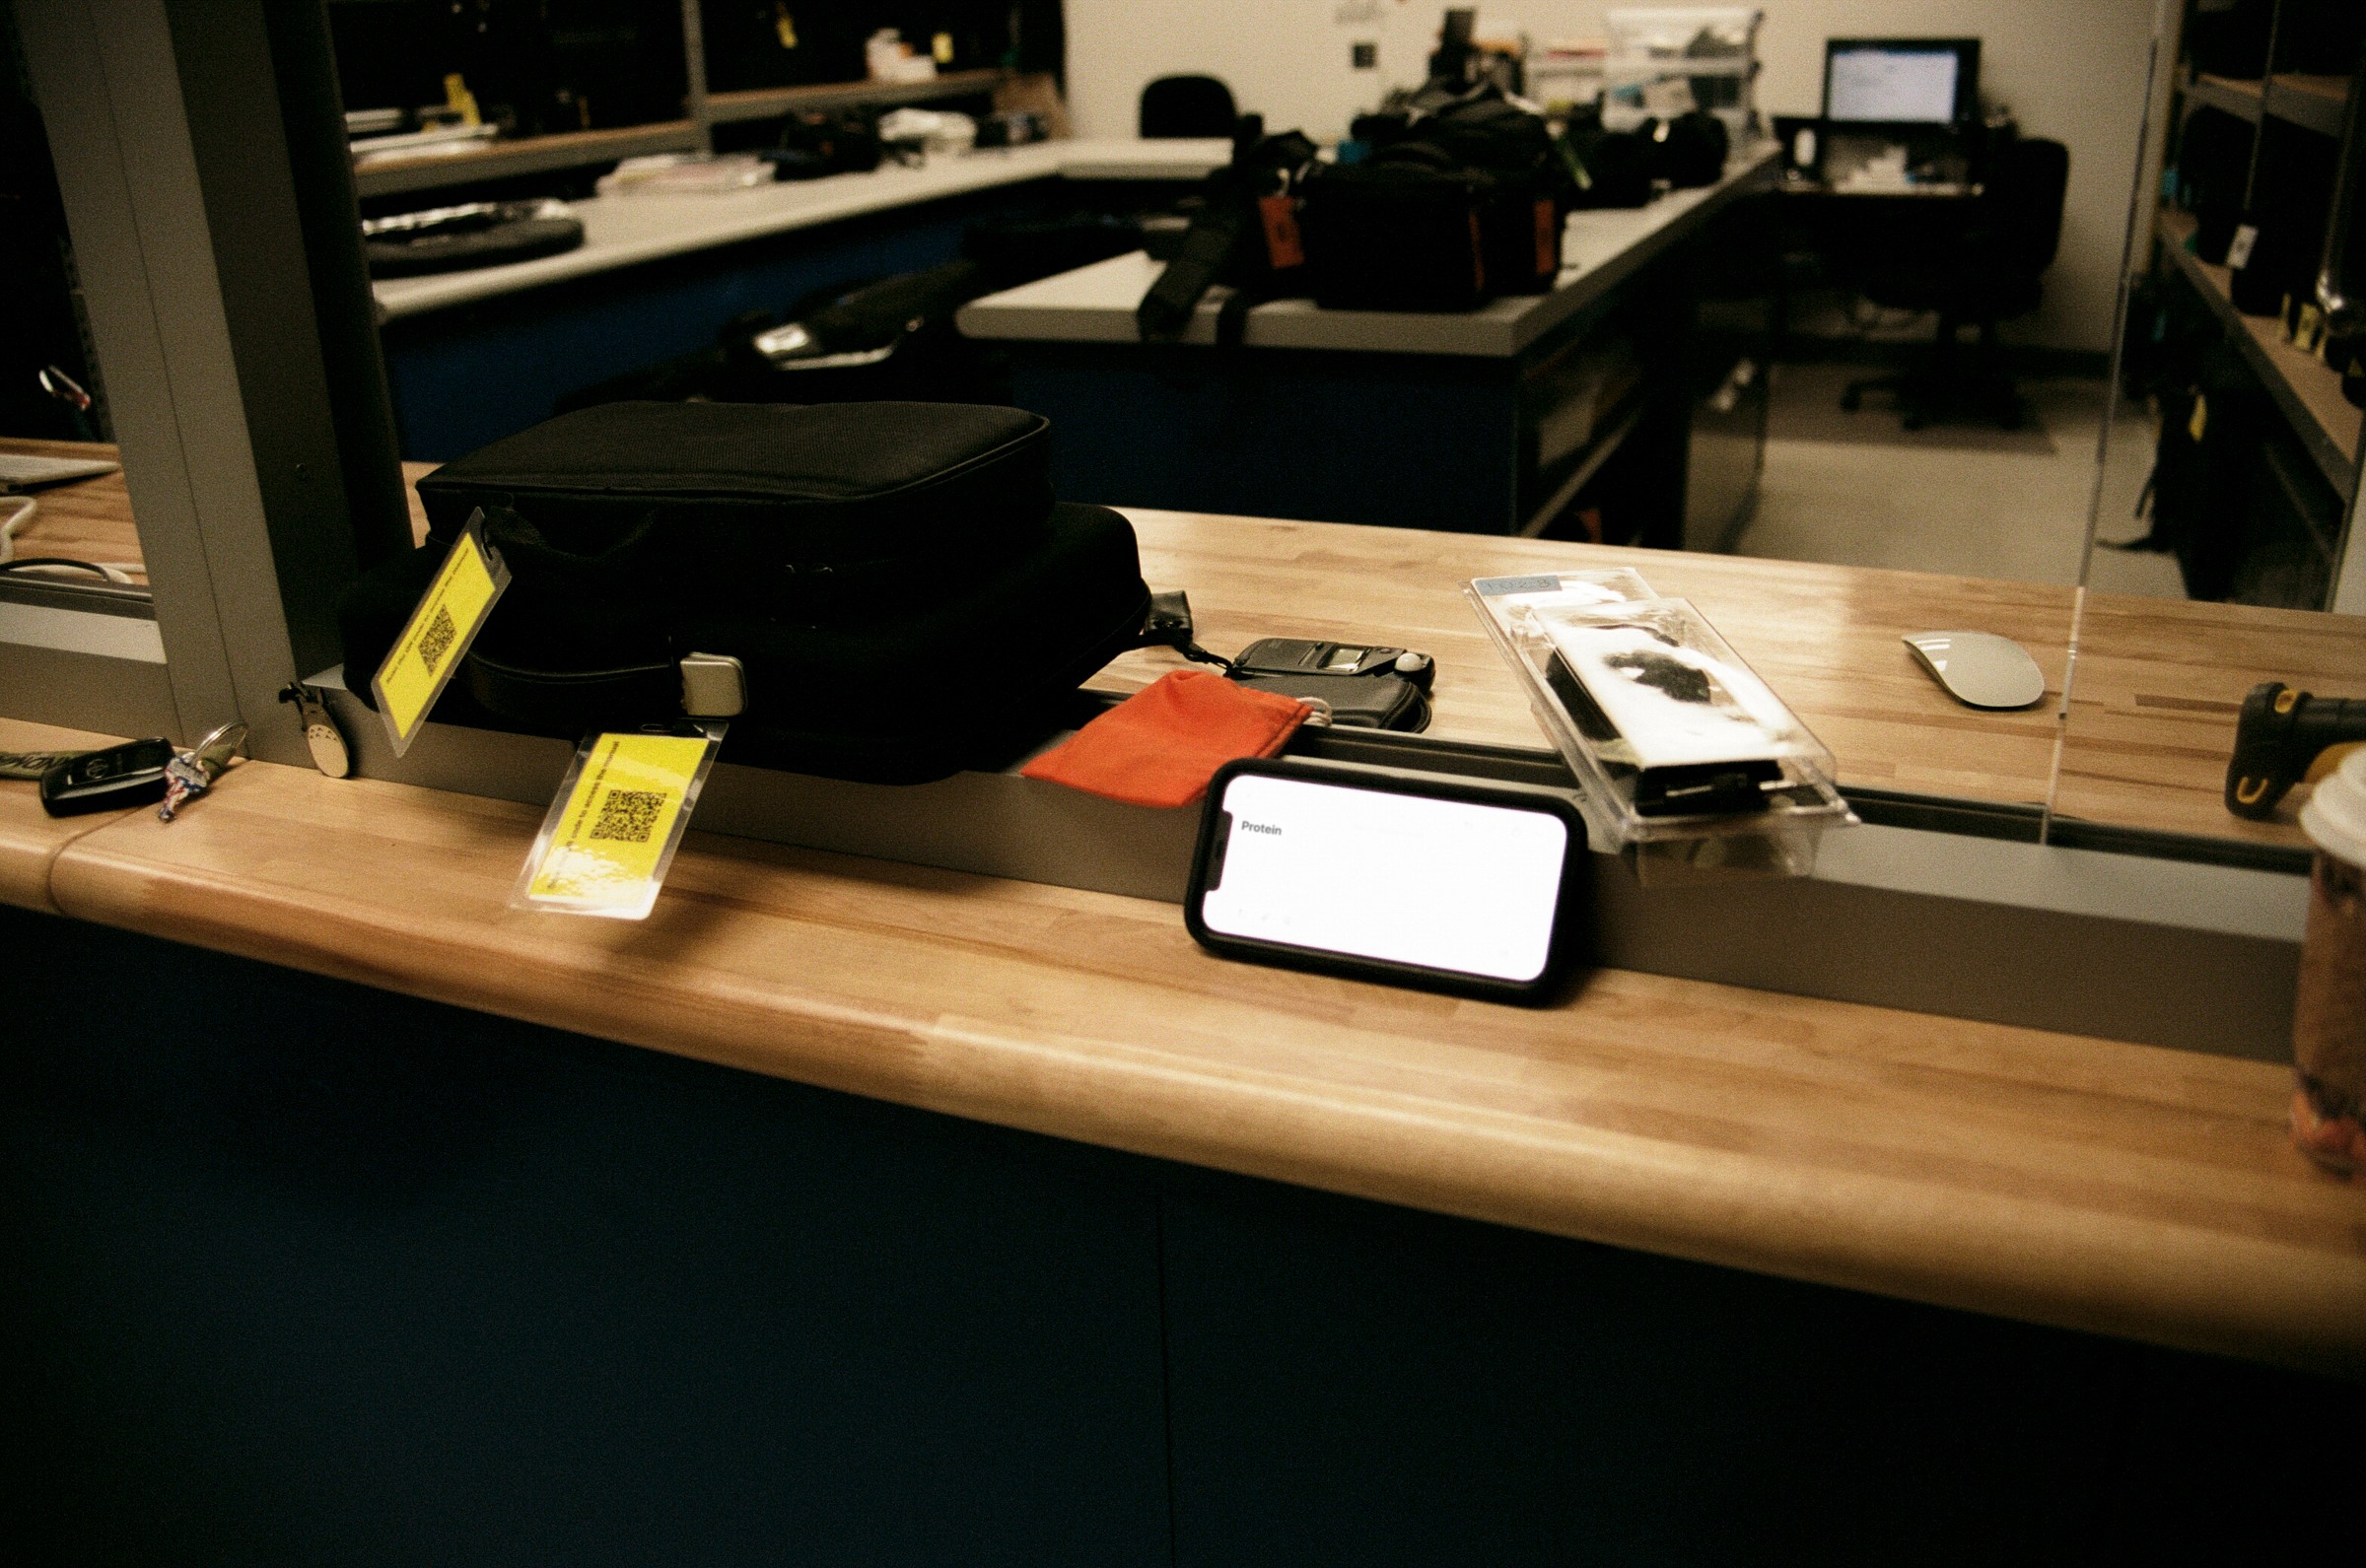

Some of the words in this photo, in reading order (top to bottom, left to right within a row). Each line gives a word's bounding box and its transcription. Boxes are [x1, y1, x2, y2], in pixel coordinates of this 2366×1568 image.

[572, 819, 583, 838] code
[579, 809, 588, 818] to
[585, 781, 600, 809] access
[595, 769, 607, 782] the
[602, 741, 620, 769] manual
[1241, 820, 1283, 836] Protein
